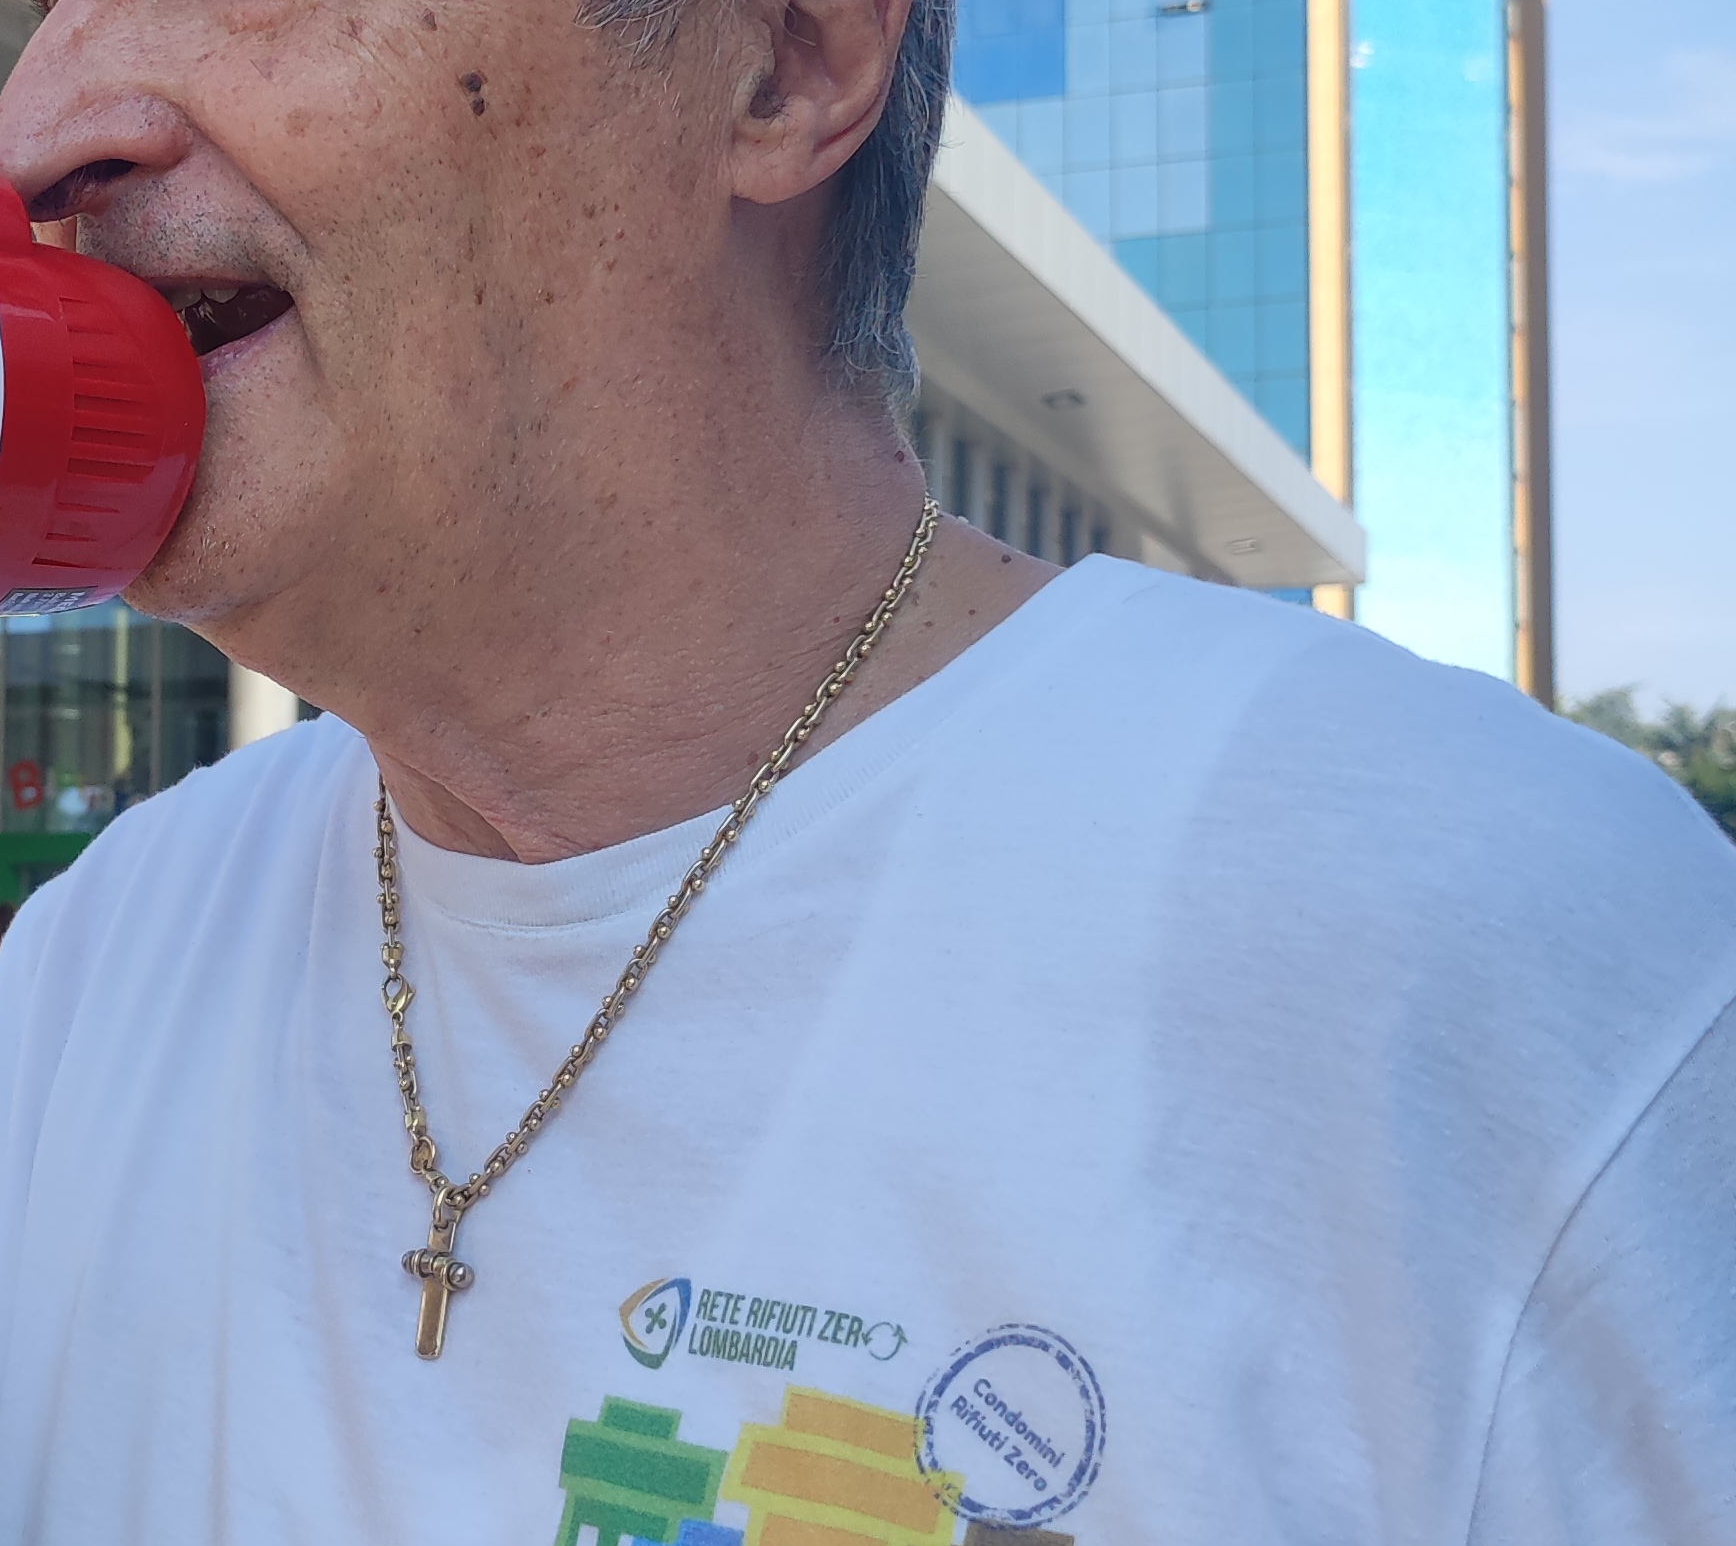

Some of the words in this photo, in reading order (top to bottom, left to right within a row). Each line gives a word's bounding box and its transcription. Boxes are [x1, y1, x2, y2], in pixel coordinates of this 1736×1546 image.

[688, 1323, 799, 1372] LOMBARDIA
[695, 1288, 746, 1325] RETE
[745, 1297, 818, 1338] RIFIUTI
[950, 1395, 1010, 1453] Rifiuti
[1003, 1445, 1048, 1492] Zero
[973, 1378, 1066, 1468] Condomini
